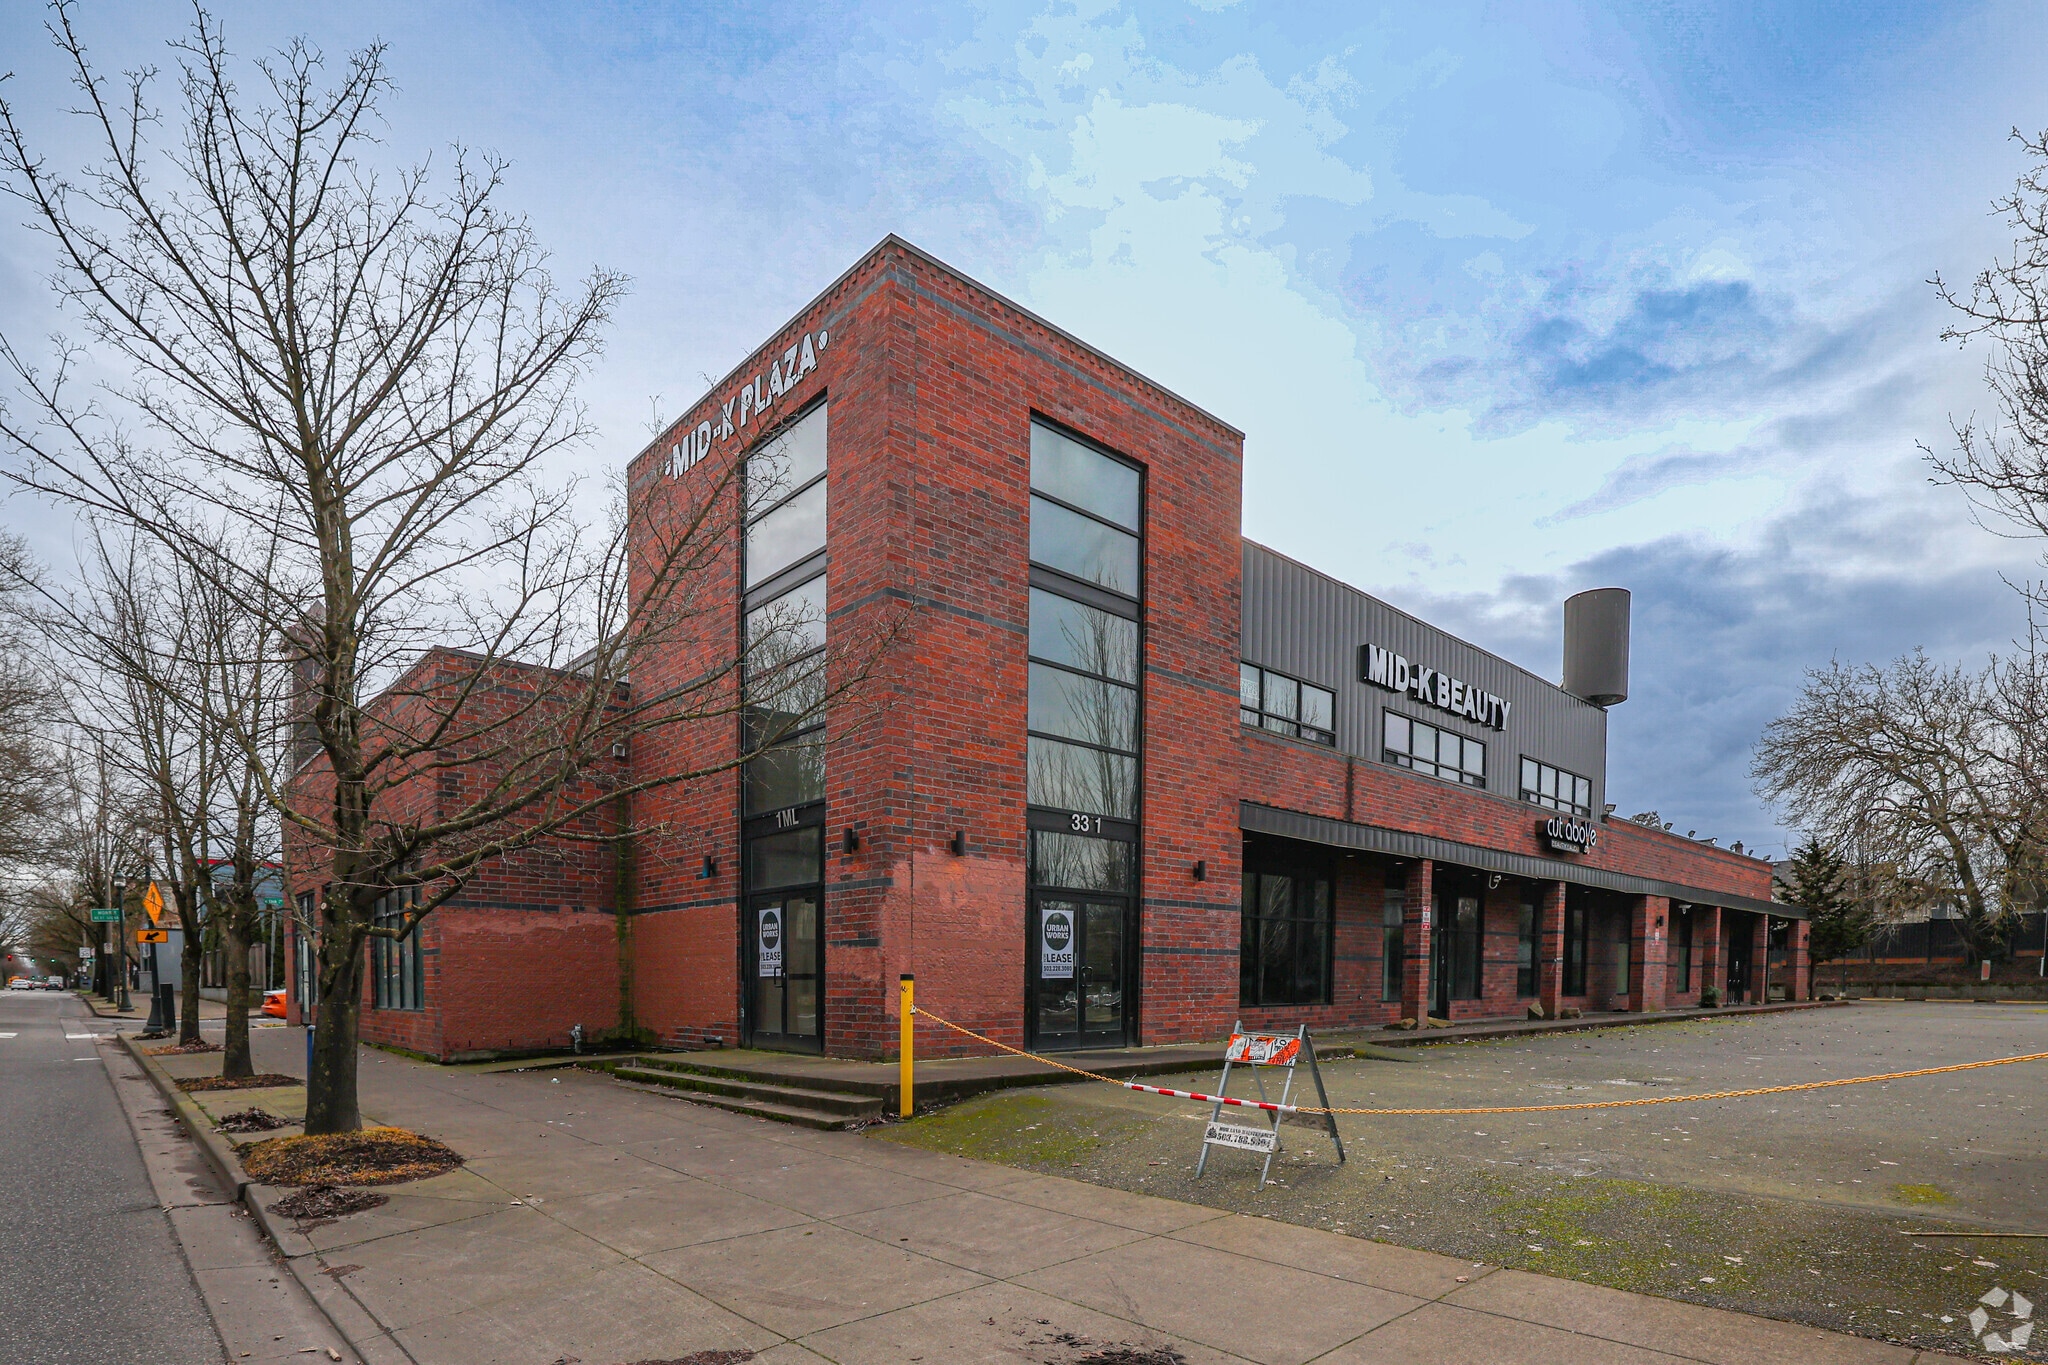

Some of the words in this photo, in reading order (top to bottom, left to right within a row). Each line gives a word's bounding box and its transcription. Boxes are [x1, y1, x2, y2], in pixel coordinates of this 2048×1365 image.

[672, 396, 736, 481] MID-K
[740, 332, 818, 428] PLAZA
[1368, 643, 1434, 703] MID-K
[1437, 672, 1512, 731] BEAUTY
[1547, 817, 1563, 839] cut
[1565, 817, 1597, 846] above
[763, 923, 778, 931] URBAN
[1046, 924, 1069, 932] URBAN
[763, 930, 778, 938] WORKS
[1046, 931, 1069, 939] WORKS
[762, 951, 781, 961] LEASE
[1046, 953, 1072, 963] LEASE
